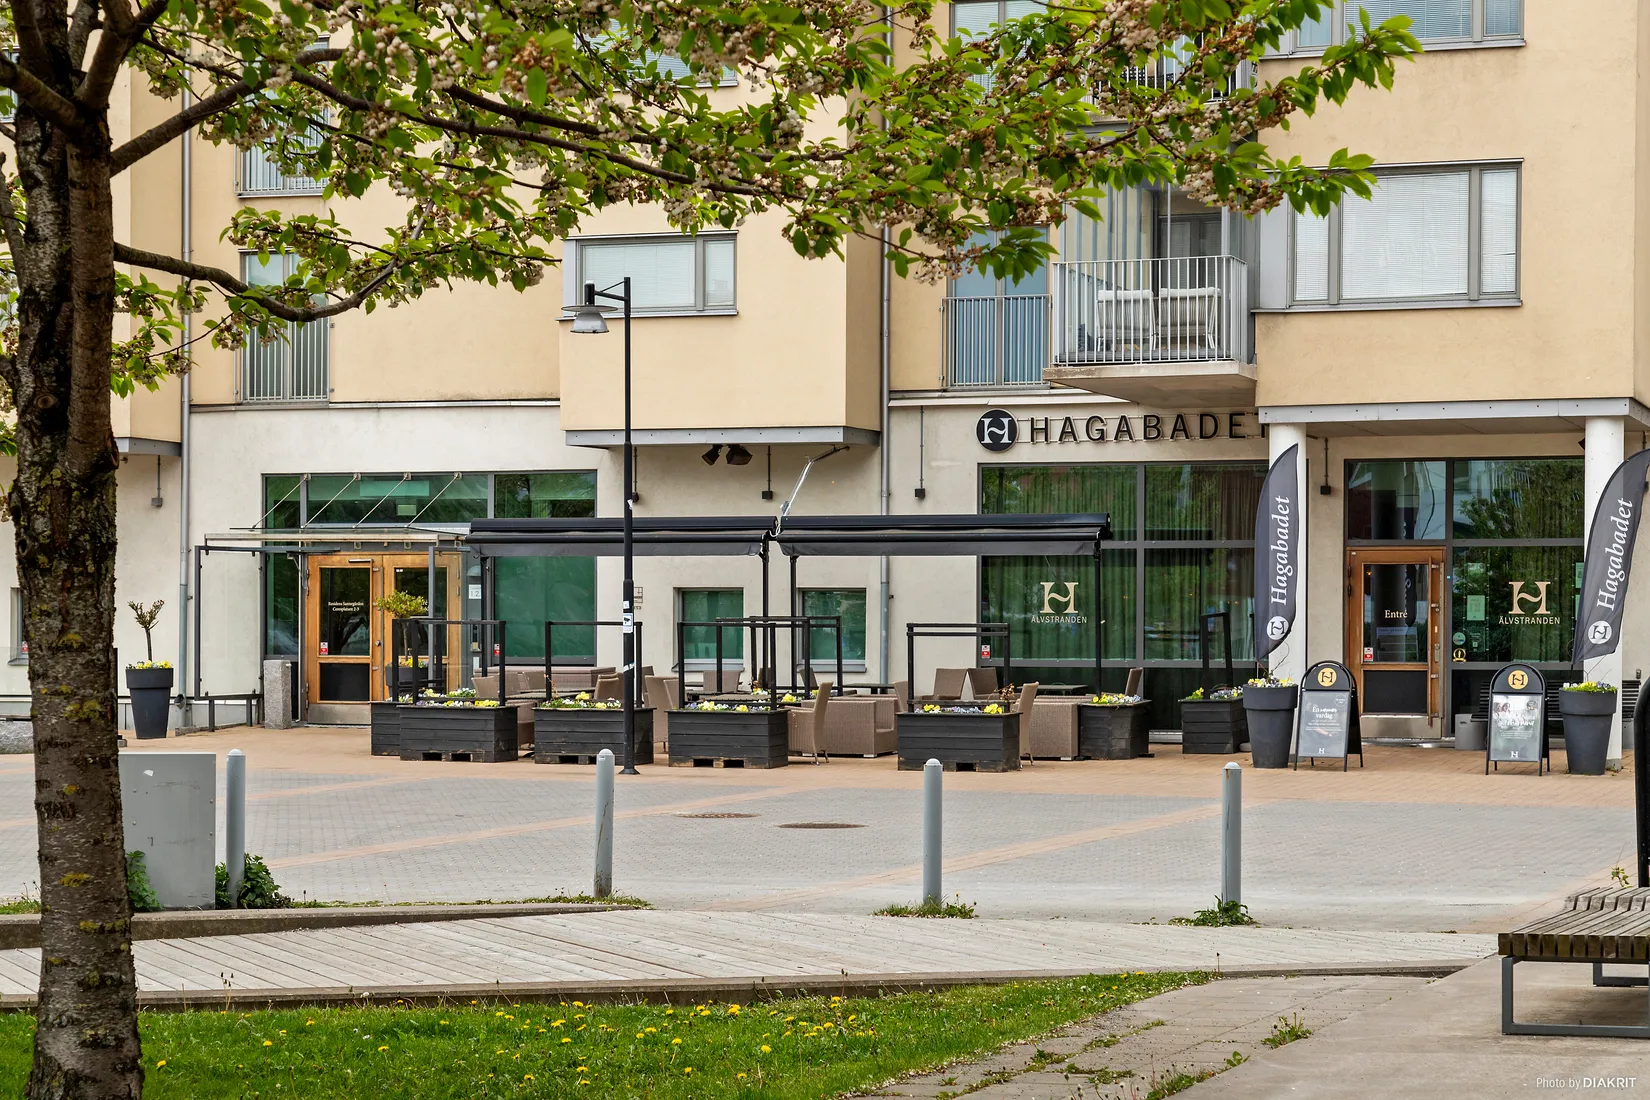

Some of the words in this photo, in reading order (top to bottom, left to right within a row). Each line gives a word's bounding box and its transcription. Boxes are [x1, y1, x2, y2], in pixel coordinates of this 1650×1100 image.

[1270, 495, 1293, 606] Hagabadet
[1596, 497, 1633, 612] Hagabadet
[1384, 609, 1408, 618] Entré
[1498, 616, 1560, 625] ÄLVSTRANDEN
